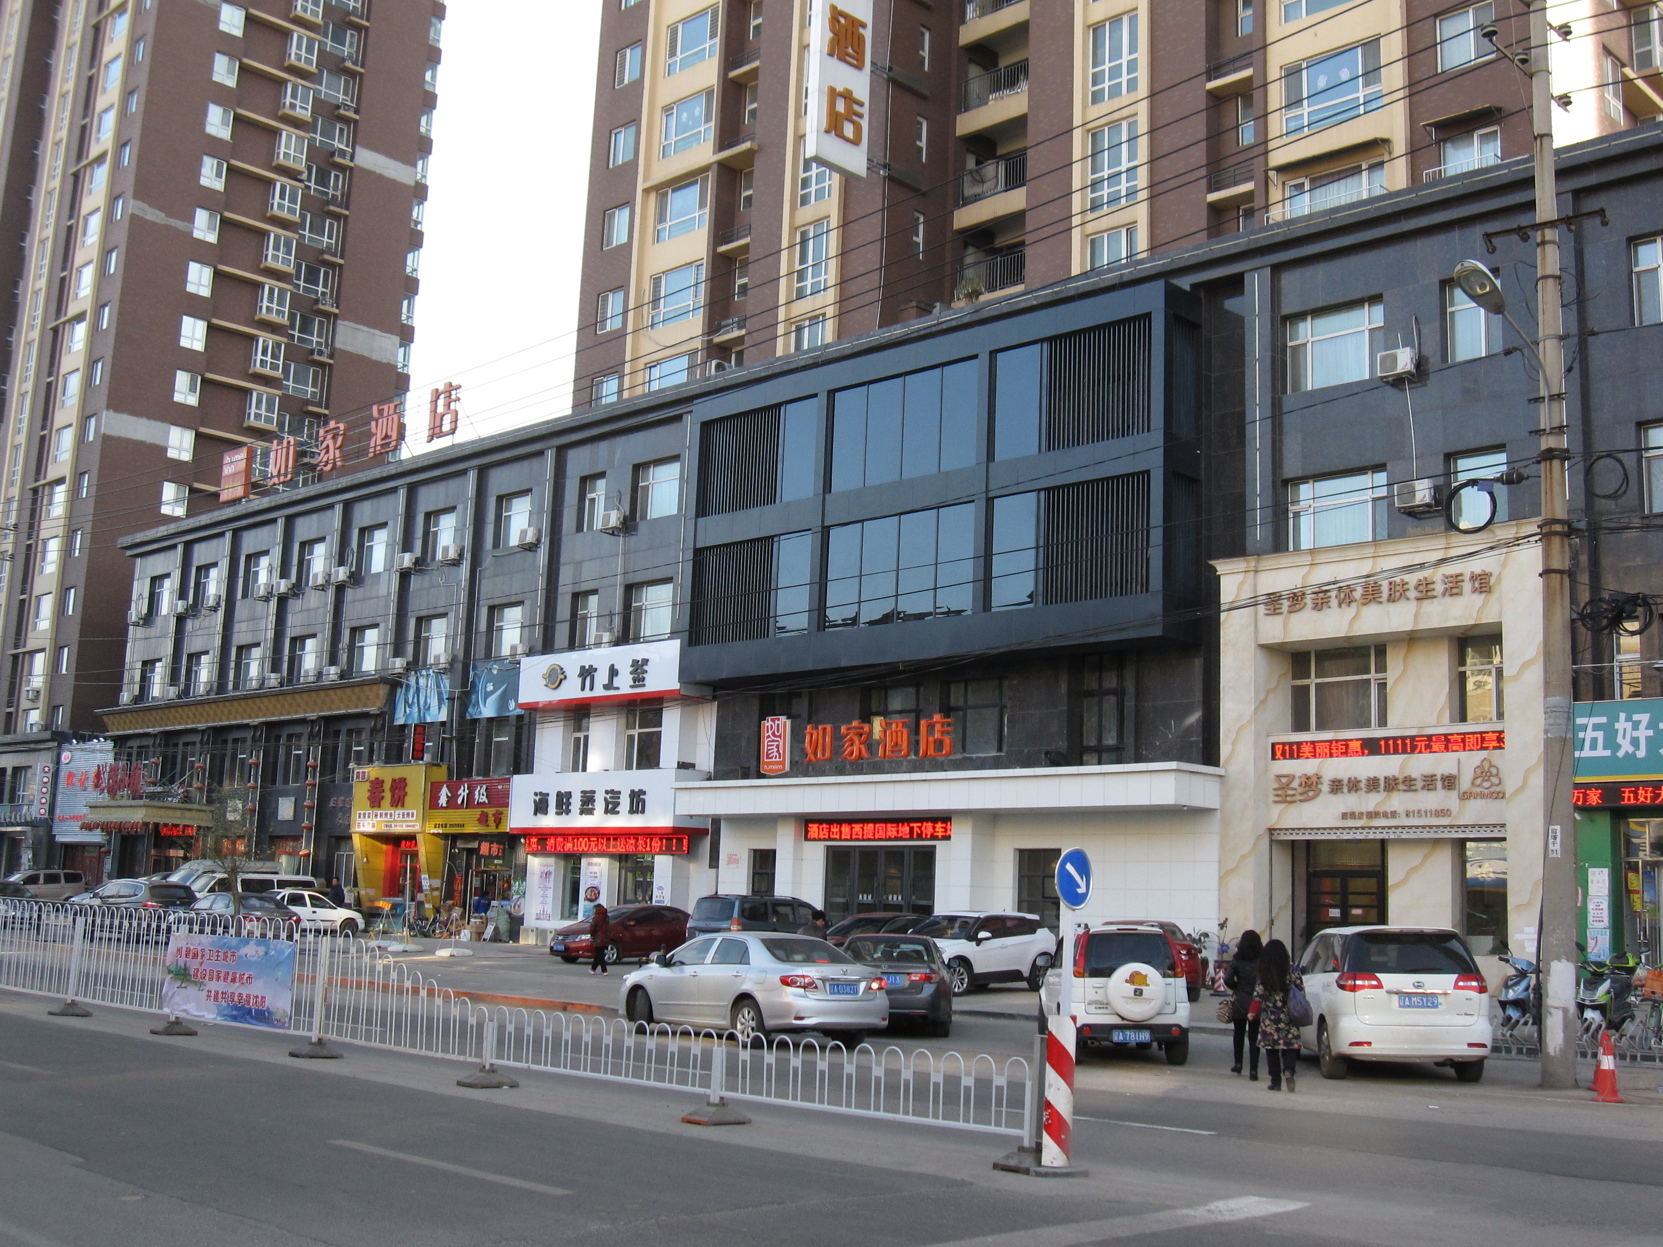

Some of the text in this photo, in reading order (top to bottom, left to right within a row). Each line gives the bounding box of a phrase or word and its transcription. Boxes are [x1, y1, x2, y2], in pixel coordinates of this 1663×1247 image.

[824, 3, 867, 146] 酒店
[269, 382, 461, 486] 如家酒店
[1263, 569, 1492, 616] 圣梦亲体美肤生活馆
[805, 713, 954, 763] 如家酒店
[1574, 712, 1663, 758] 五好
[367, 777, 408, 808] 春饼
[533, 789, 646, 816] 海鲜蒸汽坊
[1272, 772, 1457, 804] 圣梦 亲体美肤生活馆
